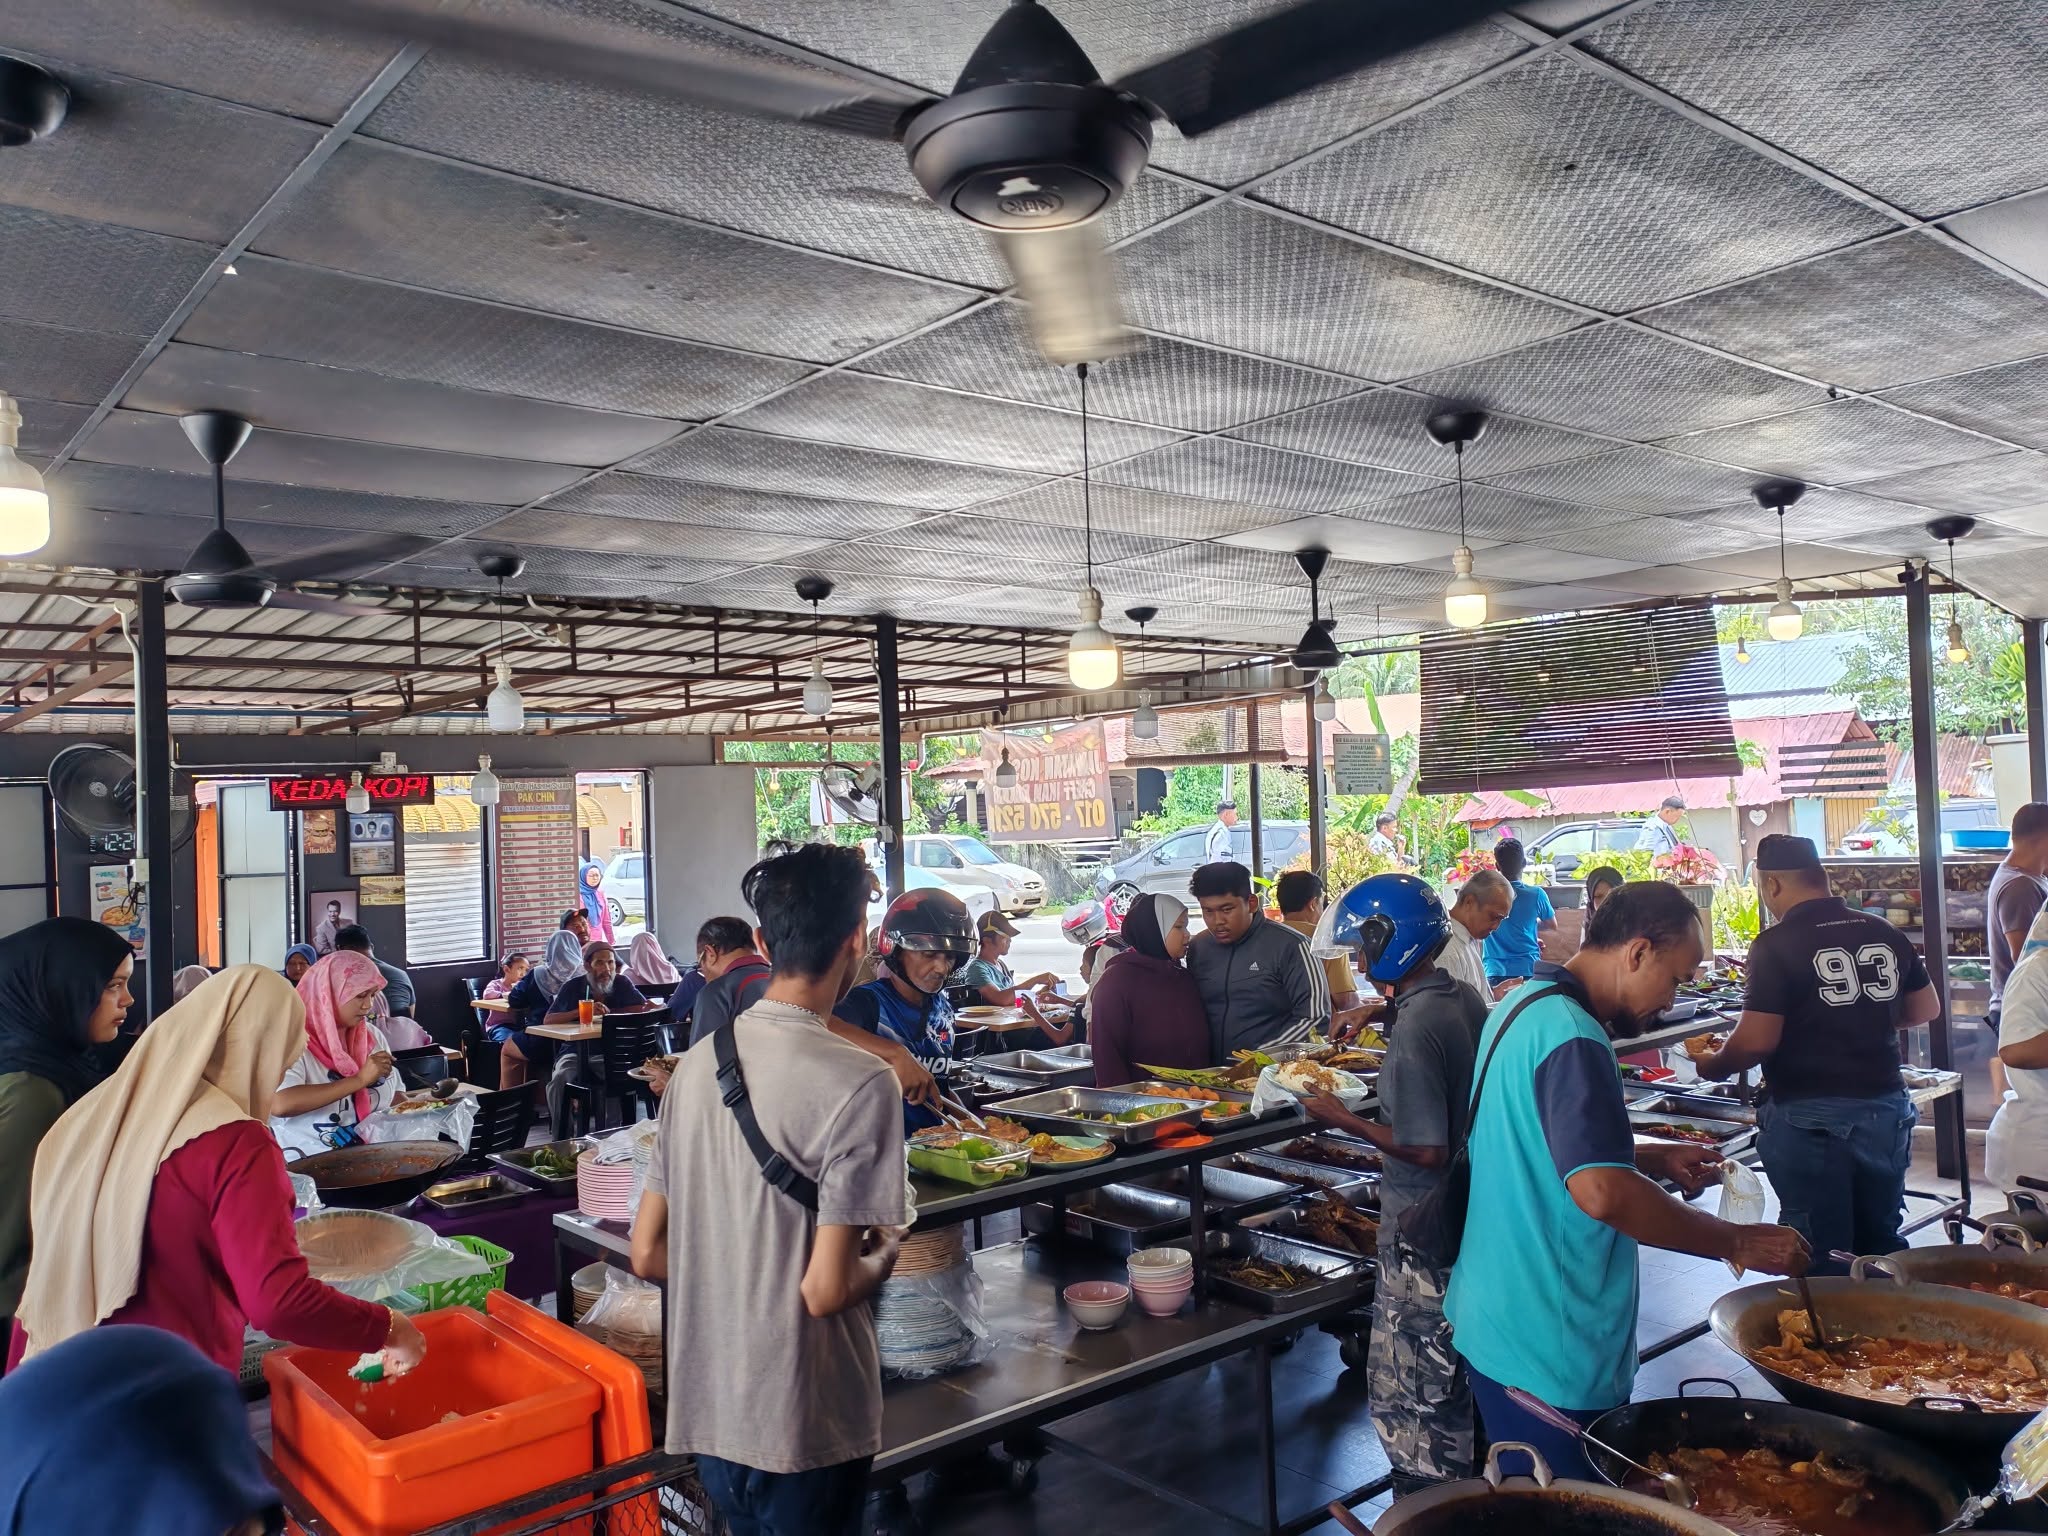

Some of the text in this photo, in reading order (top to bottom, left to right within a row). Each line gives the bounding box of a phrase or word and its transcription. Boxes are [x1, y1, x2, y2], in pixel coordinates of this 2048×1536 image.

[272, 777, 429, 800] KEDA KOPI
[518, 791, 555, 803] PAK CHIN
[101, 832, 136, 851] 12:2
[1813, 943, 1900, 1006] 93
